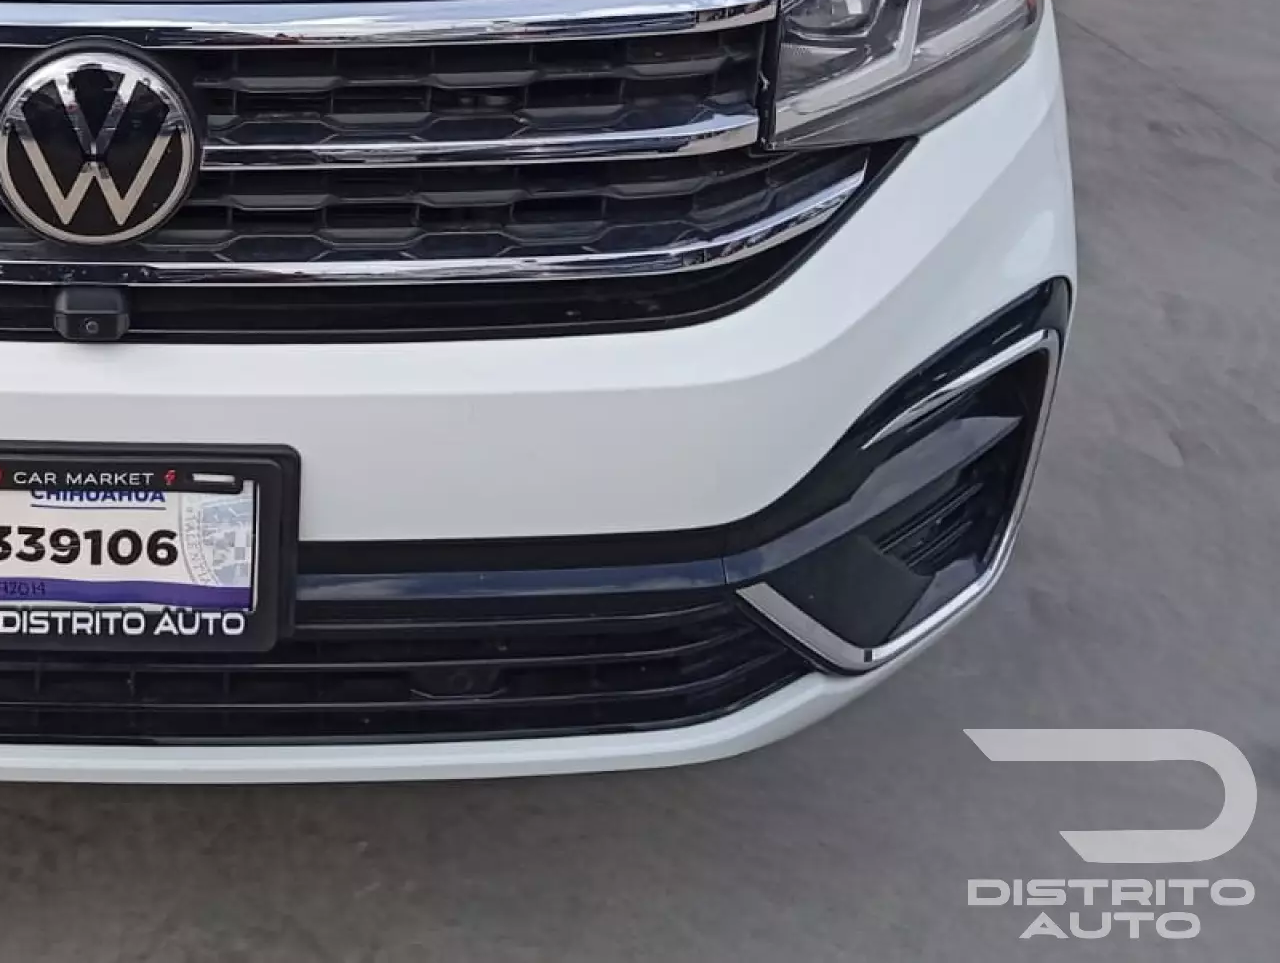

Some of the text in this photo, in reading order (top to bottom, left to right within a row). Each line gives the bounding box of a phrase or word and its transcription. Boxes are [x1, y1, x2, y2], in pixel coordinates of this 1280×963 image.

[14, 471, 155, 486] CAR MARKET
[154, 610, 246, 636] AUTO
